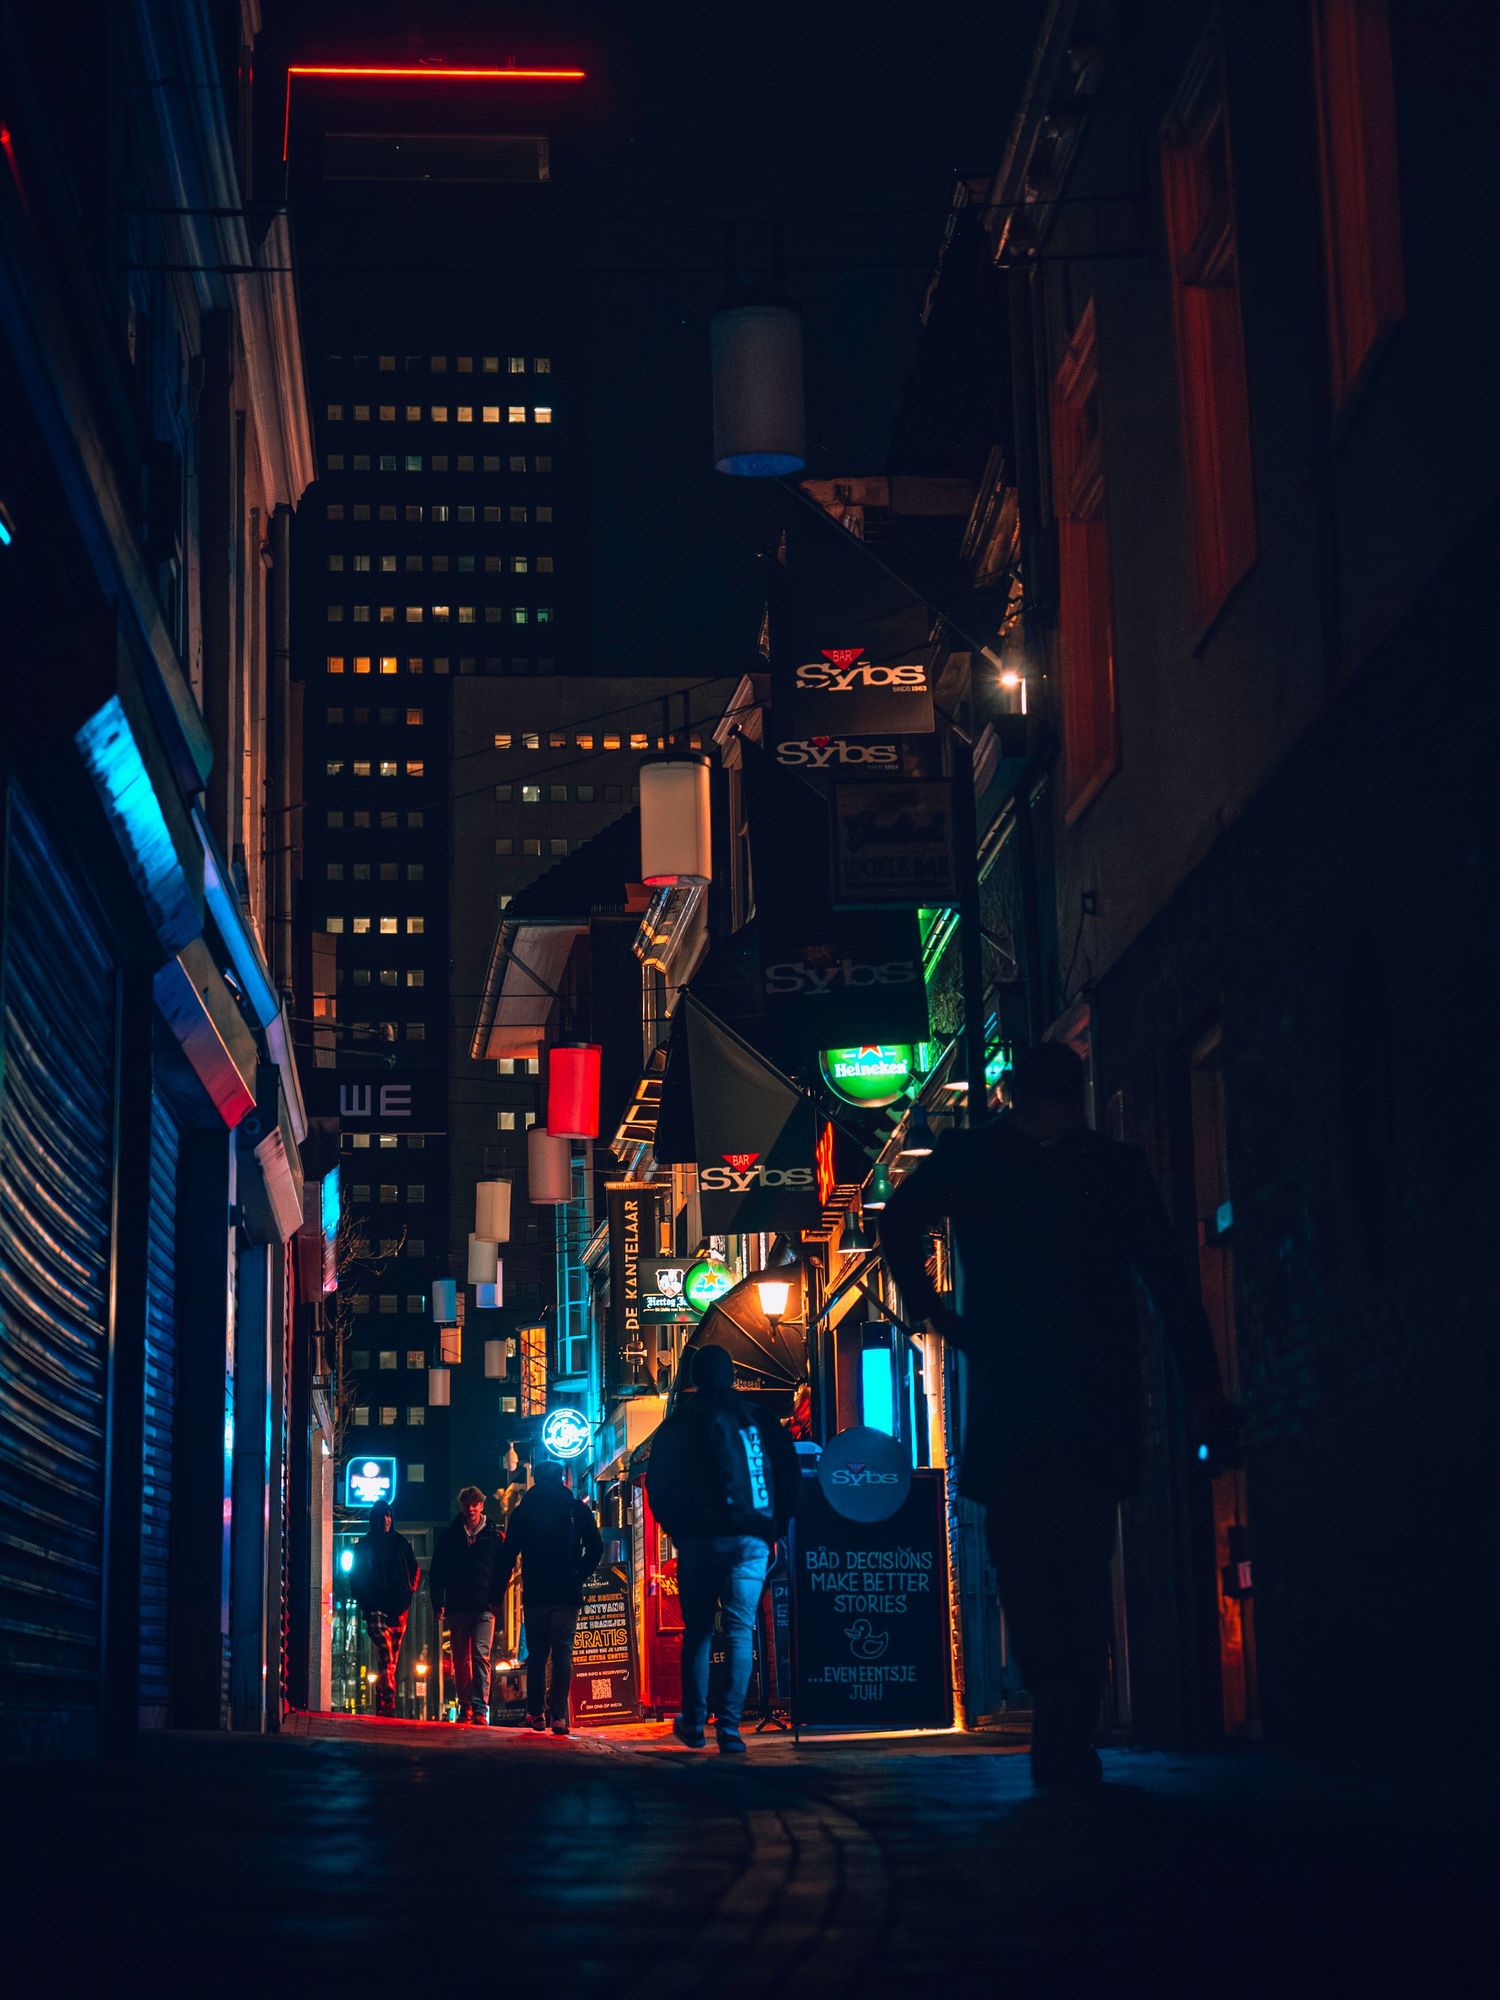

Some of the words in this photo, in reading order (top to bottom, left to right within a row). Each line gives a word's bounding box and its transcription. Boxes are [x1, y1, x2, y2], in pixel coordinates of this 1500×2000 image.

[833, 650, 853, 663] BAR
[795, 661, 927, 692] Sybs
[776, 740, 898, 768] Sybs
[765, 959, 916, 995] Sybs
[834, 1059, 908, 1078] Heineken
[340, 1084, 412, 1117] WE
[733, 1154, 750, 1166] BAR
[700, 1164, 814, 1192] Sybs
[624, 1199, 639, 1301] KANTELAAR
[646, 1296, 677, 1309] Hertog
[625, 1307, 640, 1330] DE
[749, 1431, 768, 1500] adidas
[832, 1470, 899, 1487] Sybs
[811, 1572, 859, 1593] MAKE
[863, 1572, 931, 1593] BETTER
[833, 1593, 908, 1614] STORIES
[573, 1628, 628, 1649] GRATIS
[849, 1683, 883, 1702] JUH!
